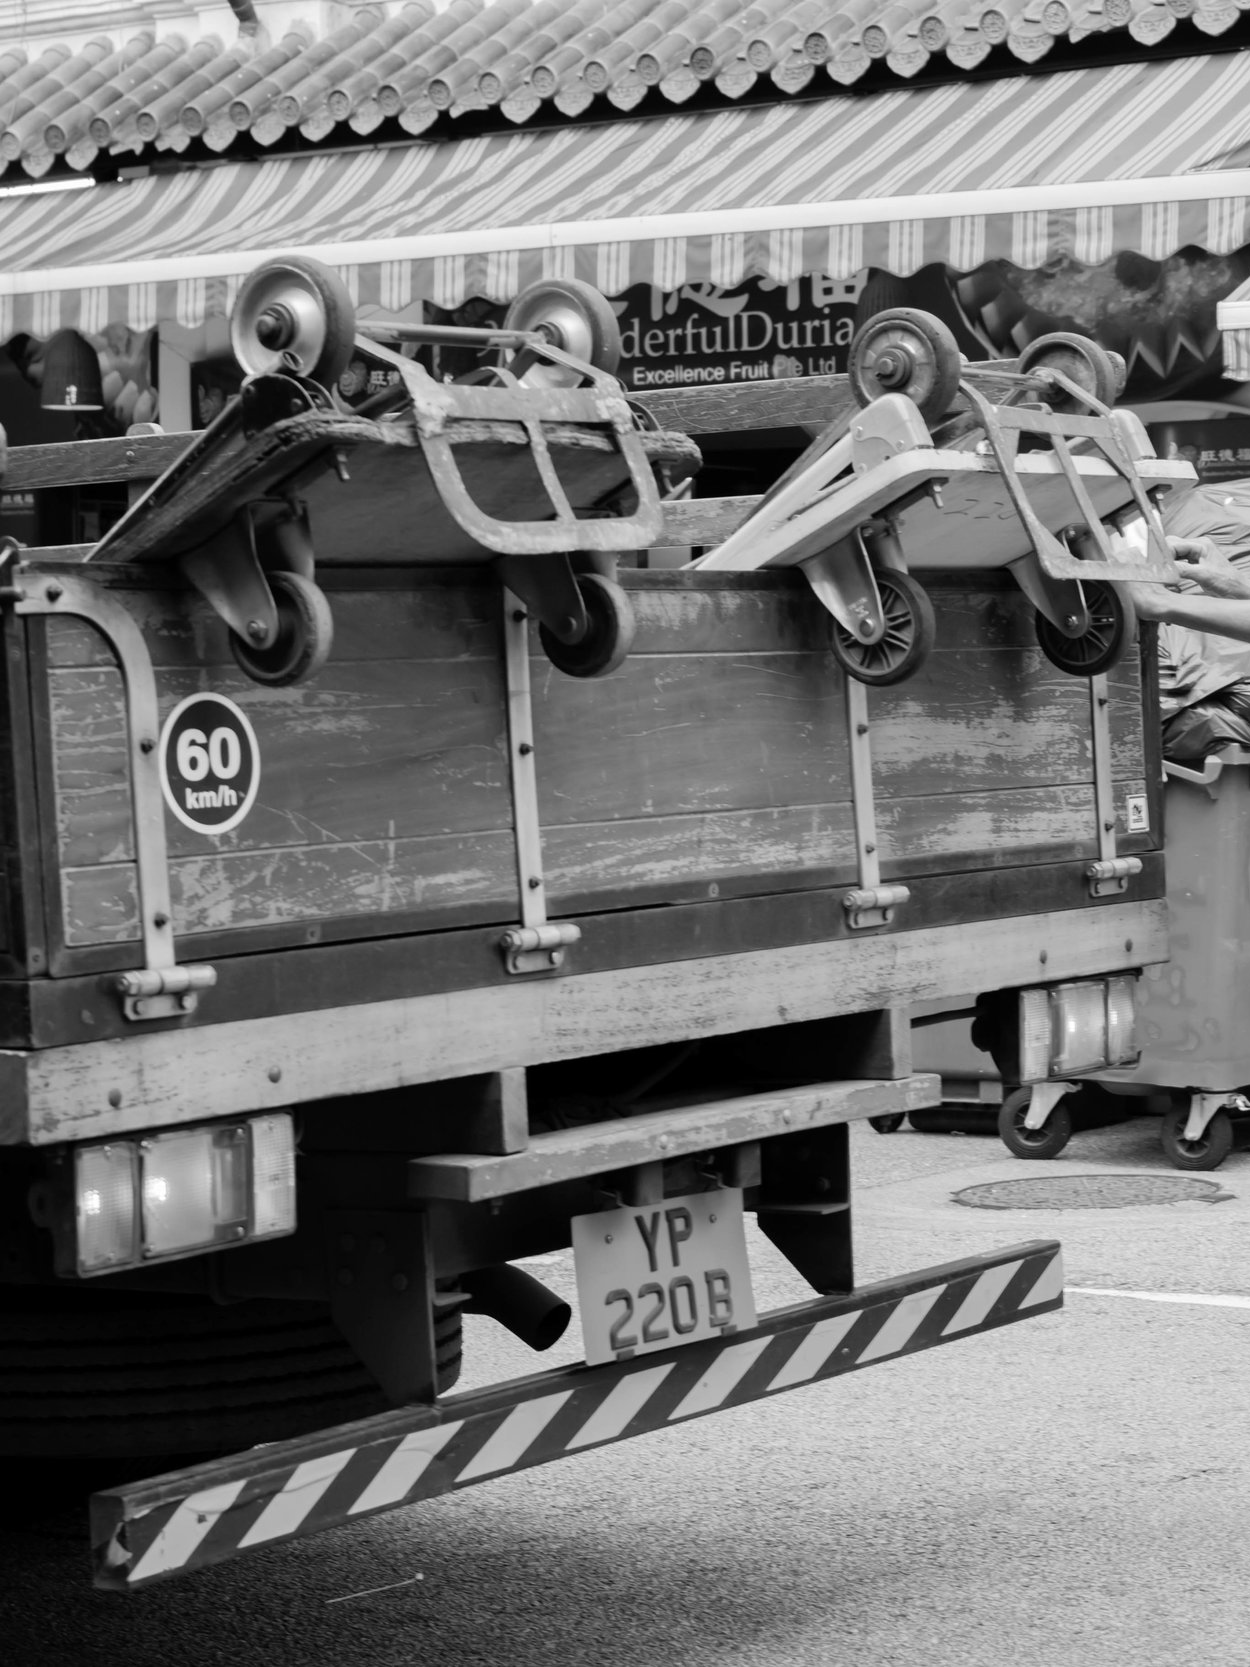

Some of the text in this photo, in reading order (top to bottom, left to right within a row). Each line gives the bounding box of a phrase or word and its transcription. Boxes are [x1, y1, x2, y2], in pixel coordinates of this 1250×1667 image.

[618, 305, 855, 359] derfulDuria
[633, 362, 725, 386] Excellence
[730, 359, 769, 381] Fruit
[808, 355, 837, 376] Ltd
[176, 726, 242, 782] 60
[185, 784, 238, 810] km/h
[634, 1206, 694, 1273] YP
[604, 1268, 734, 1352] 220B
